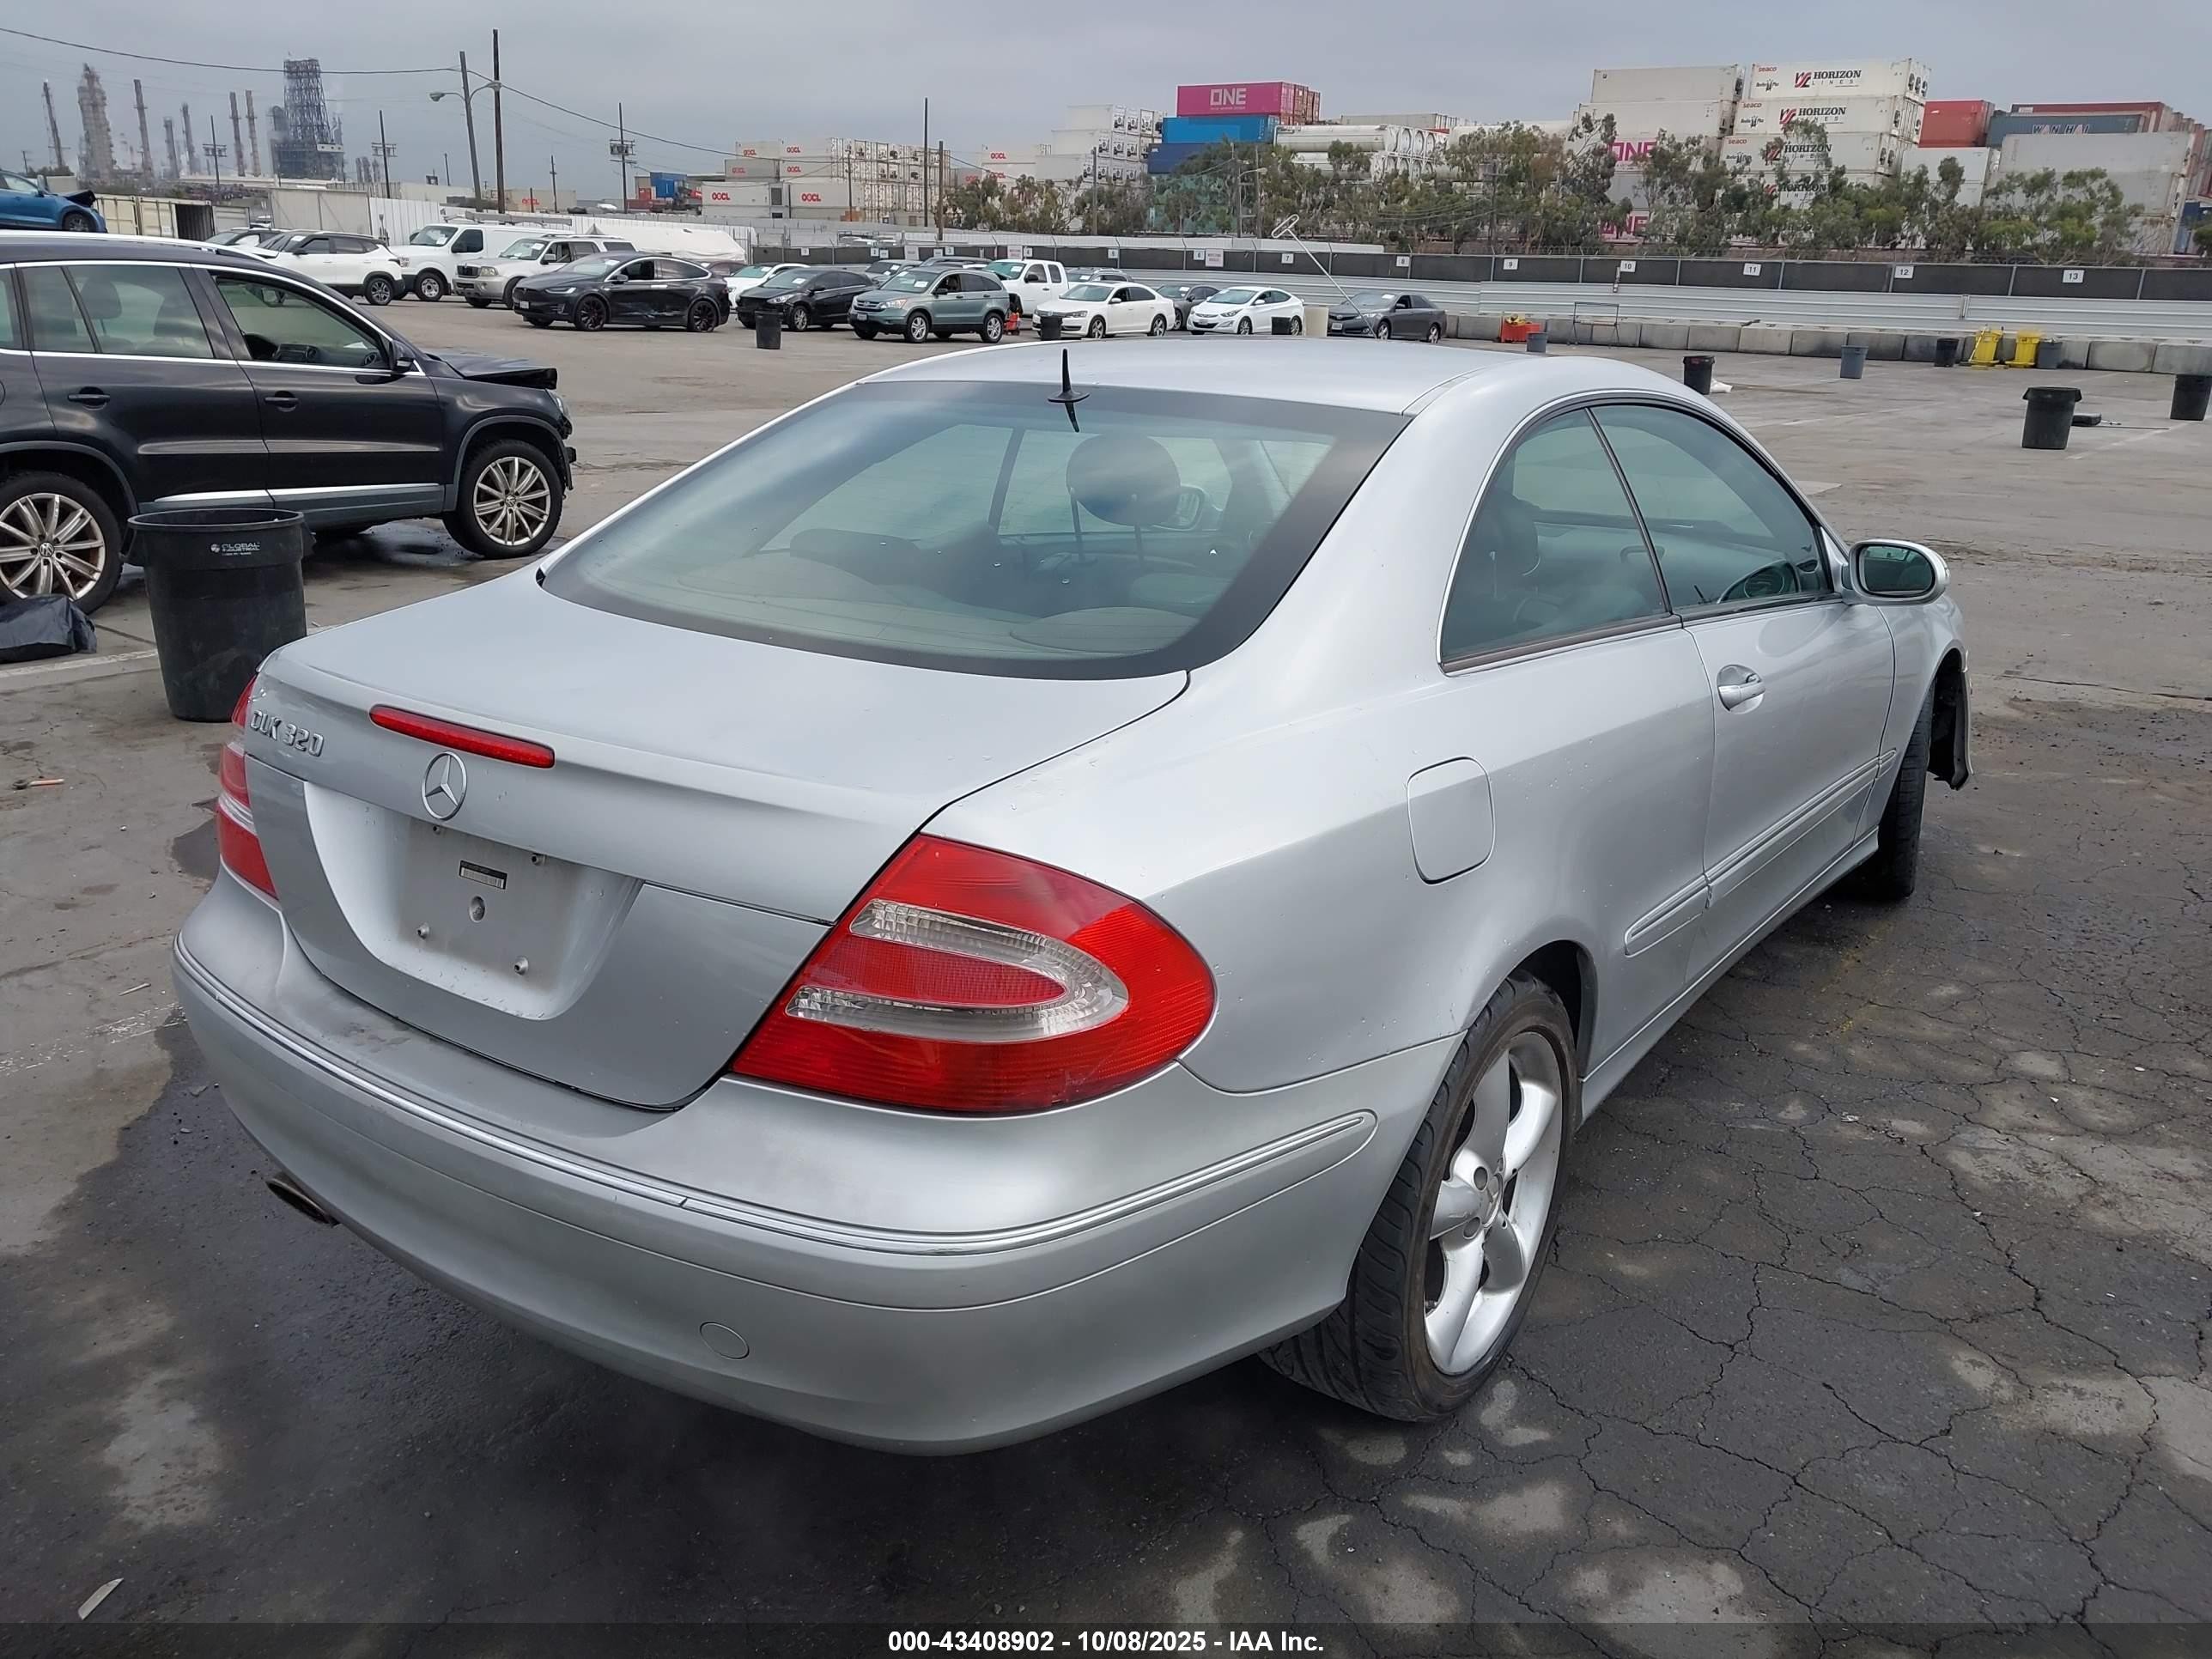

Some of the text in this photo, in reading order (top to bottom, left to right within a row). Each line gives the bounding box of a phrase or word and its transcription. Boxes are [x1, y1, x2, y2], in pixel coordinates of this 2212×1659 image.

[1814, 70, 1862, 80] HORIZON
[1209, 88, 1247, 106] ONE
[1798, 107, 1847, 116] HORIZON
[2032, 124, 2090, 135] WAN HAI
[1784, 143, 1832, 153] HORIZON
[283, 723, 325, 757] 320
